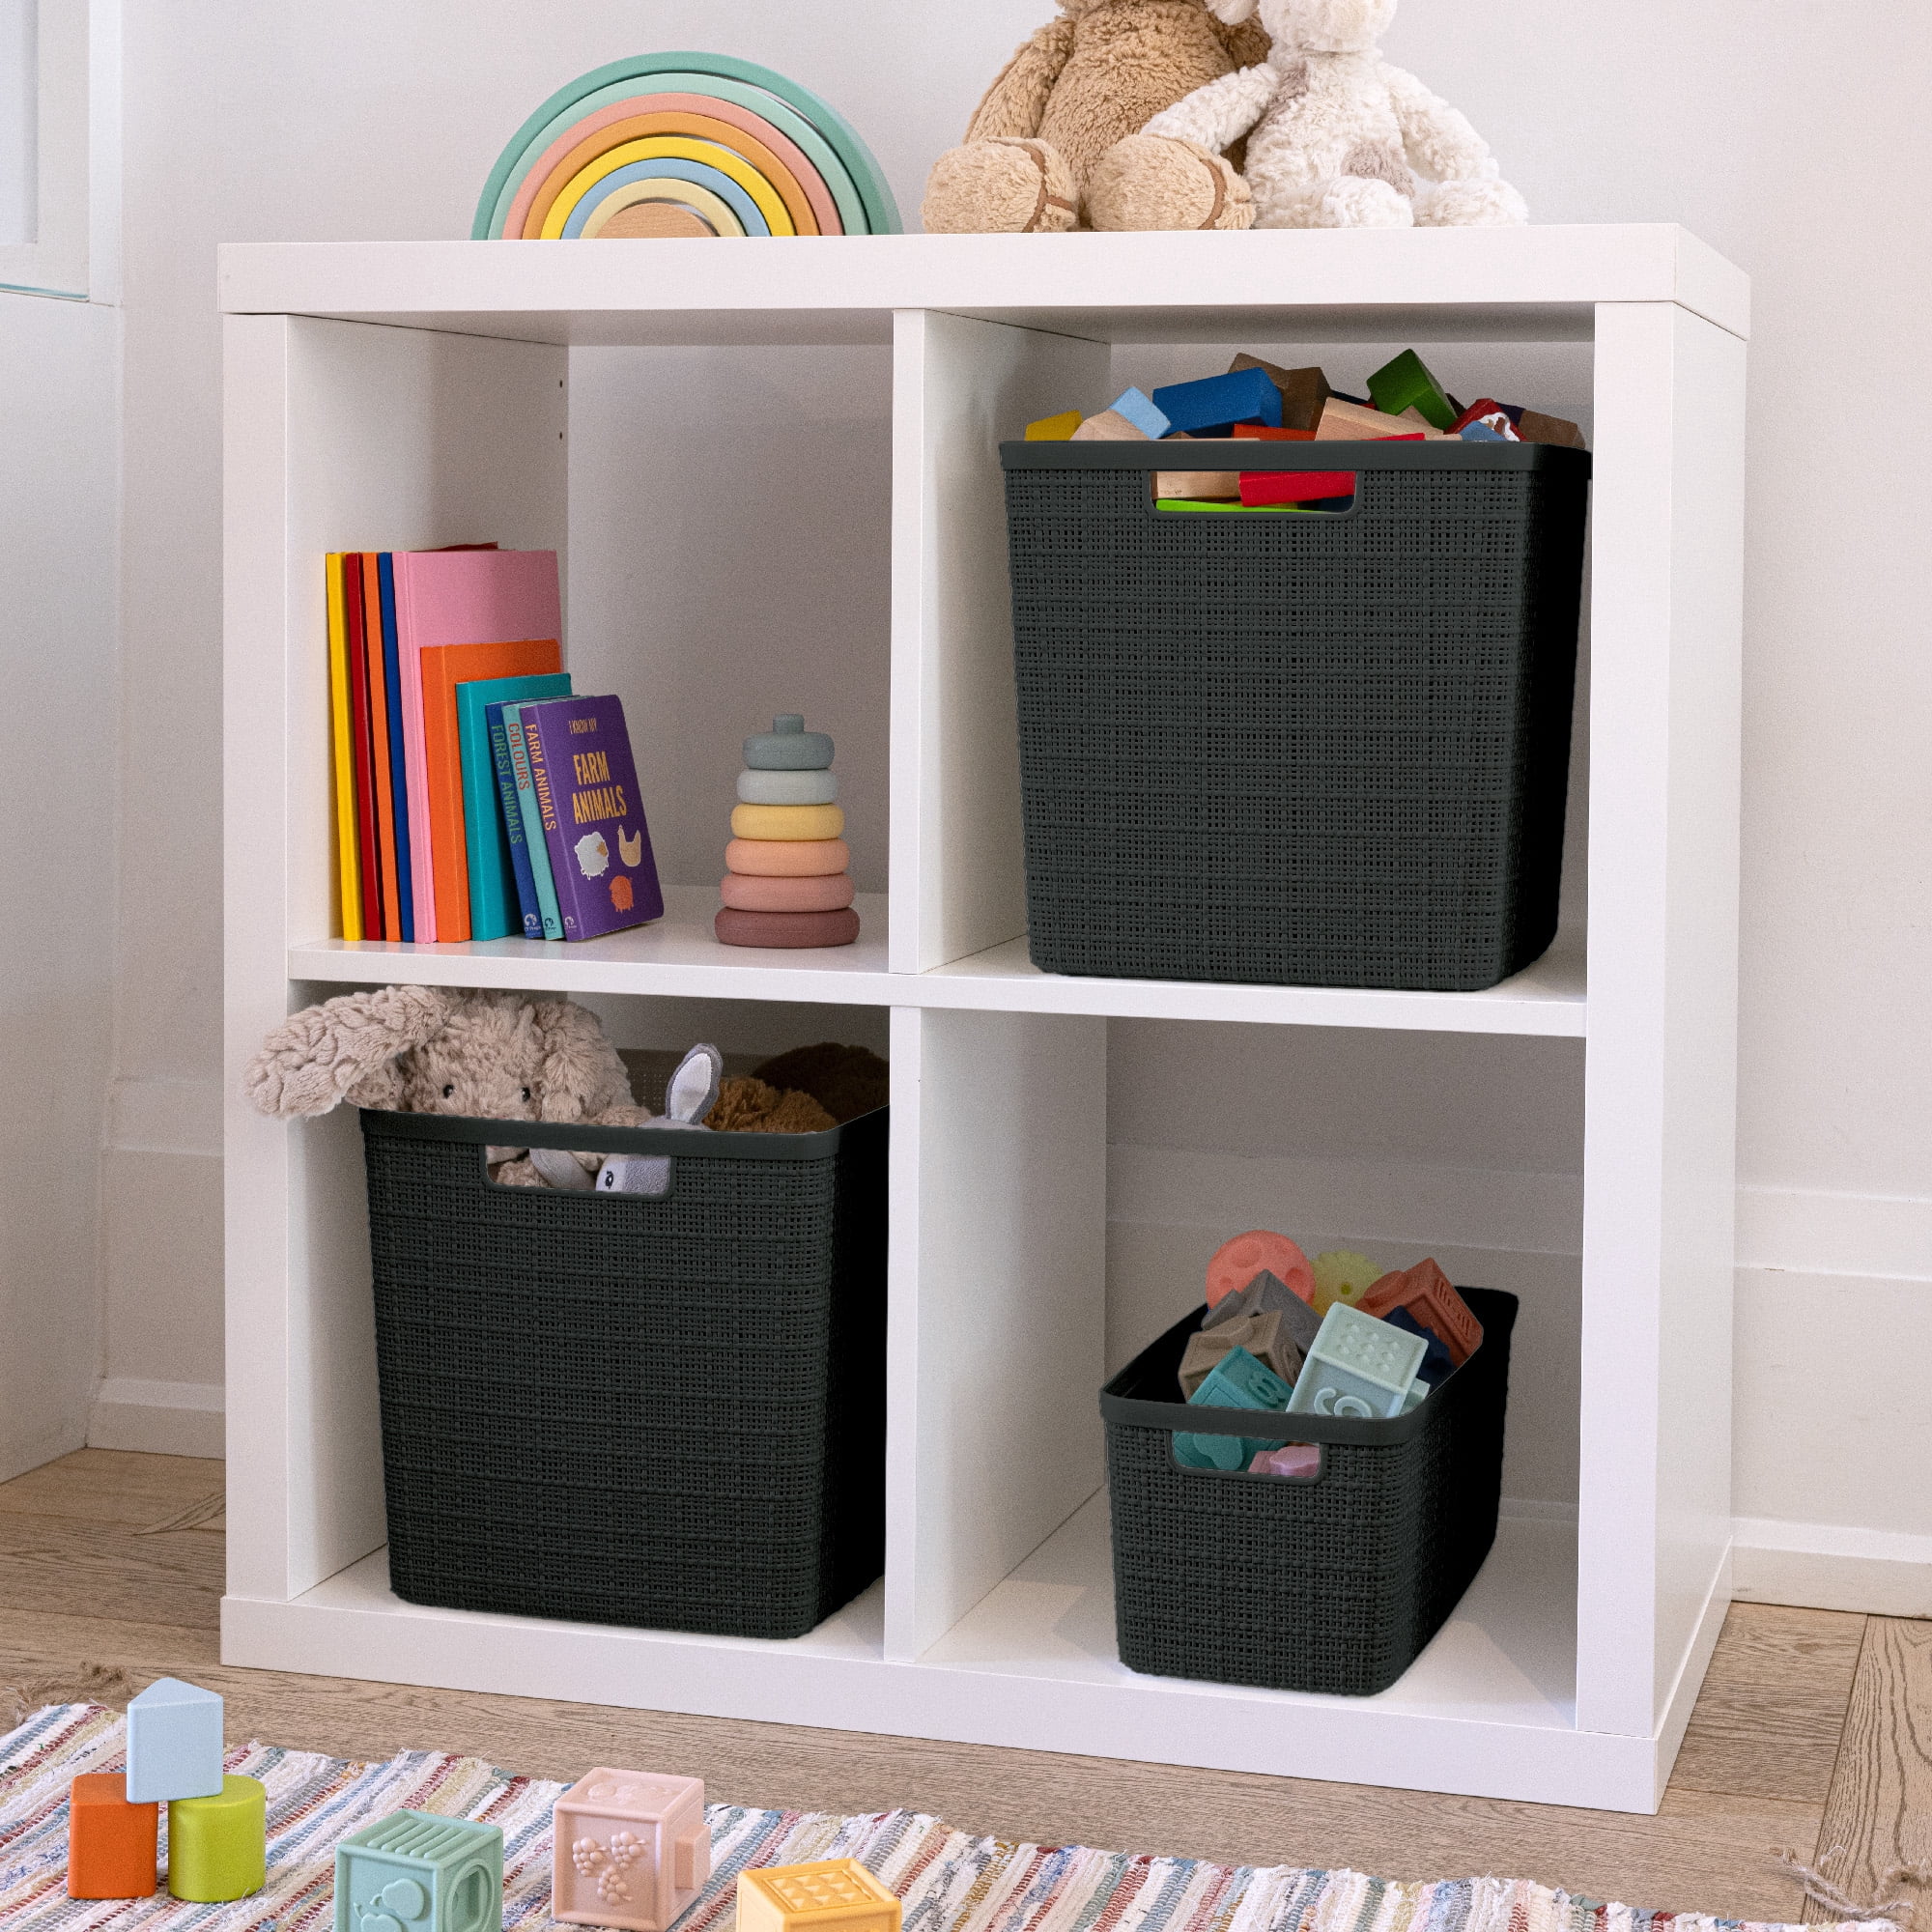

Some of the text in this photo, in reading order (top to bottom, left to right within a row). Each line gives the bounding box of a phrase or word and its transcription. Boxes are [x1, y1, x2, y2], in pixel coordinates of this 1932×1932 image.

[492, 724, 523, 844] FOREST ANIMALS
[508, 723, 530, 790] COLOURS
[525, 724, 556, 831] FARM ANIMALS
[573, 751, 611, 785] FARM
[572, 785, 627, 824] ANIMALS
